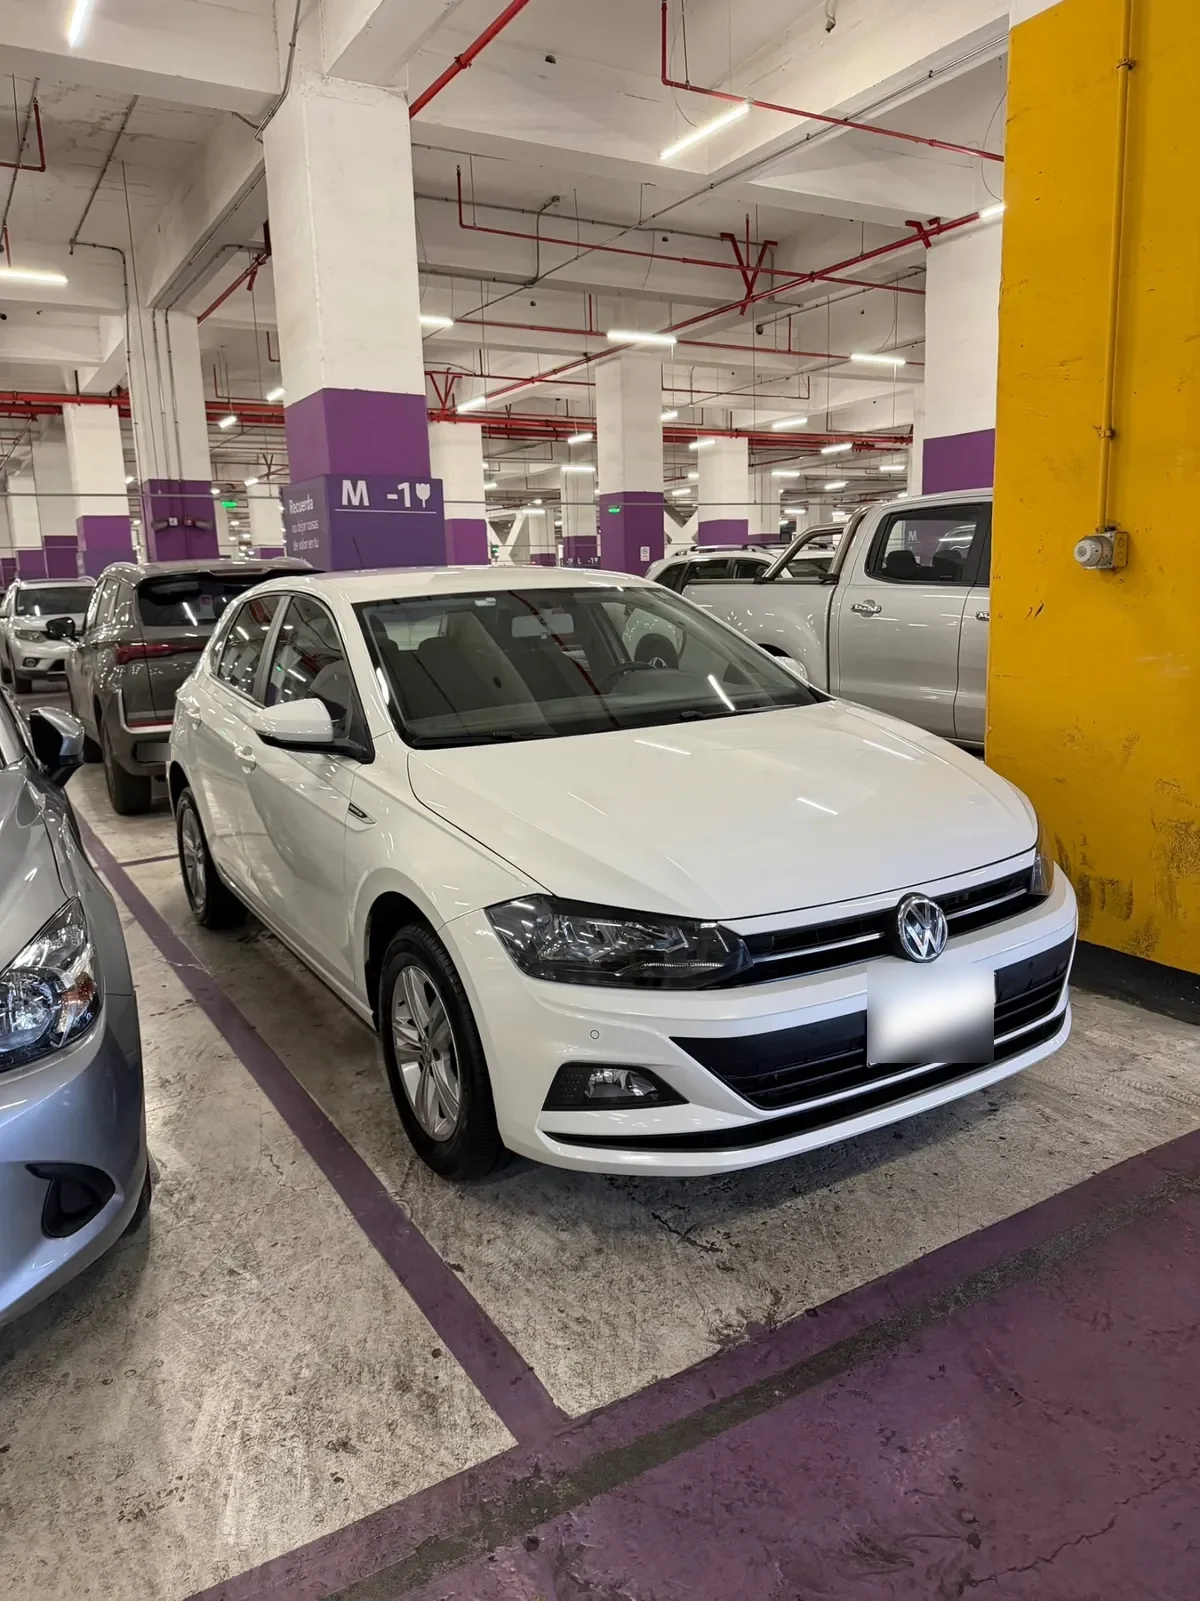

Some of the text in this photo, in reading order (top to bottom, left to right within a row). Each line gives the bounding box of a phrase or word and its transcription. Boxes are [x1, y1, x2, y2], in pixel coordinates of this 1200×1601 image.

[289, 494, 314, 514] Recuerda
[342, 480, 411, 508] M -1
[908, 530, 917, 541] M
